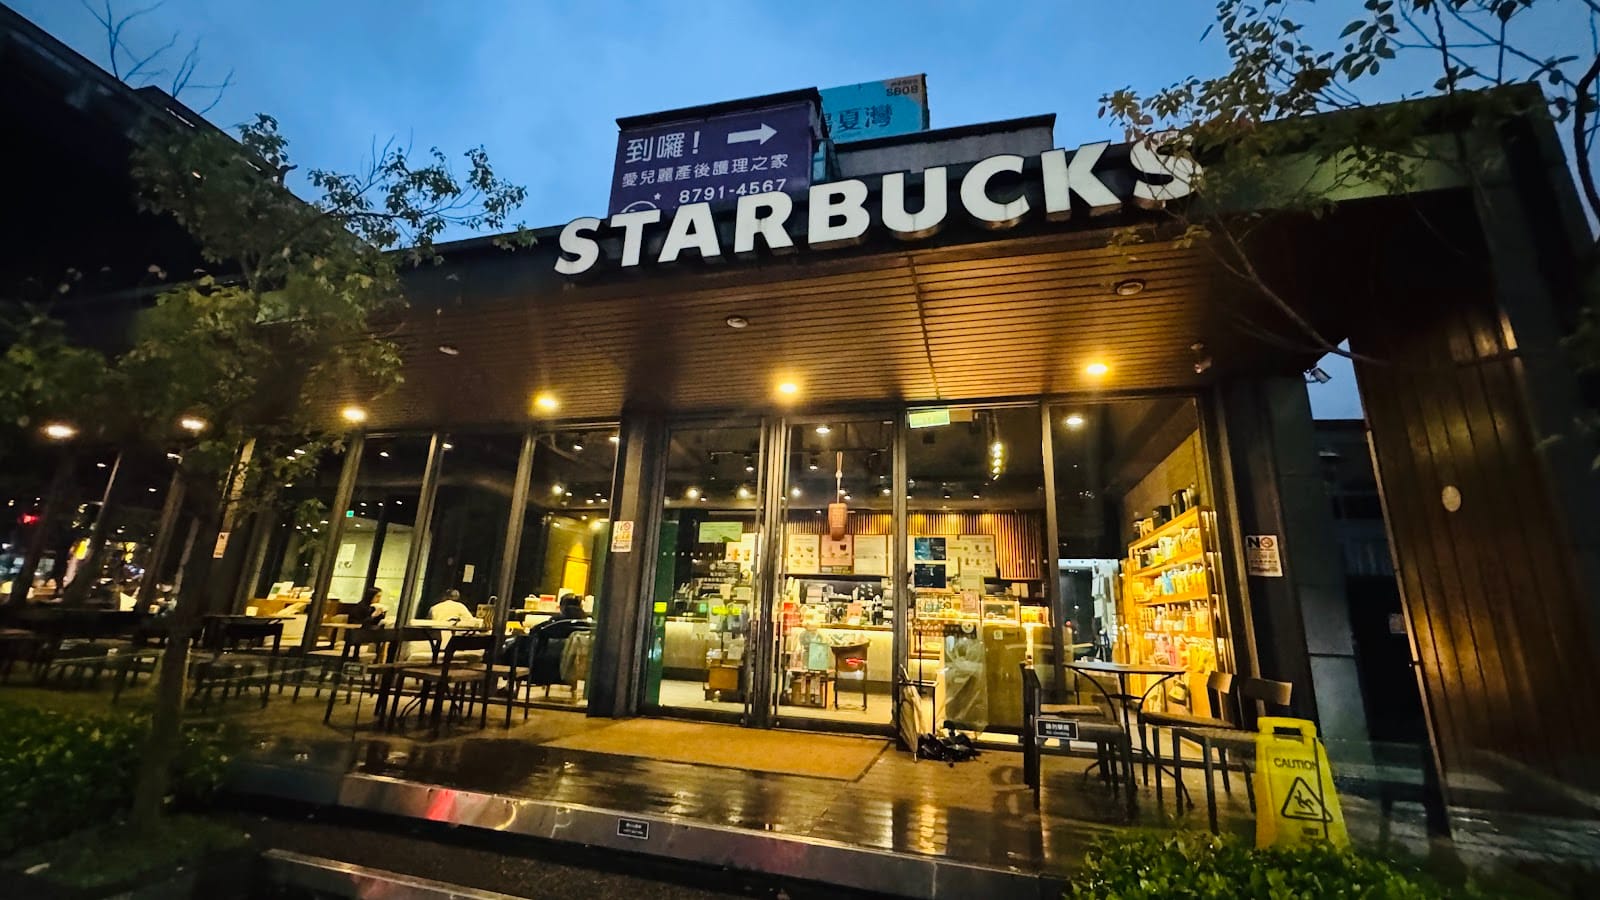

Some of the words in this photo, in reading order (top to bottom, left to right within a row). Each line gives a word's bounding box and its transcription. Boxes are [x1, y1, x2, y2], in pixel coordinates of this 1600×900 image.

[554, 129, 1202, 275] STARBUCKS
[679, 178, 787, 204] 8791-4567
[1274, 758, 1318, 770] CAUTION
